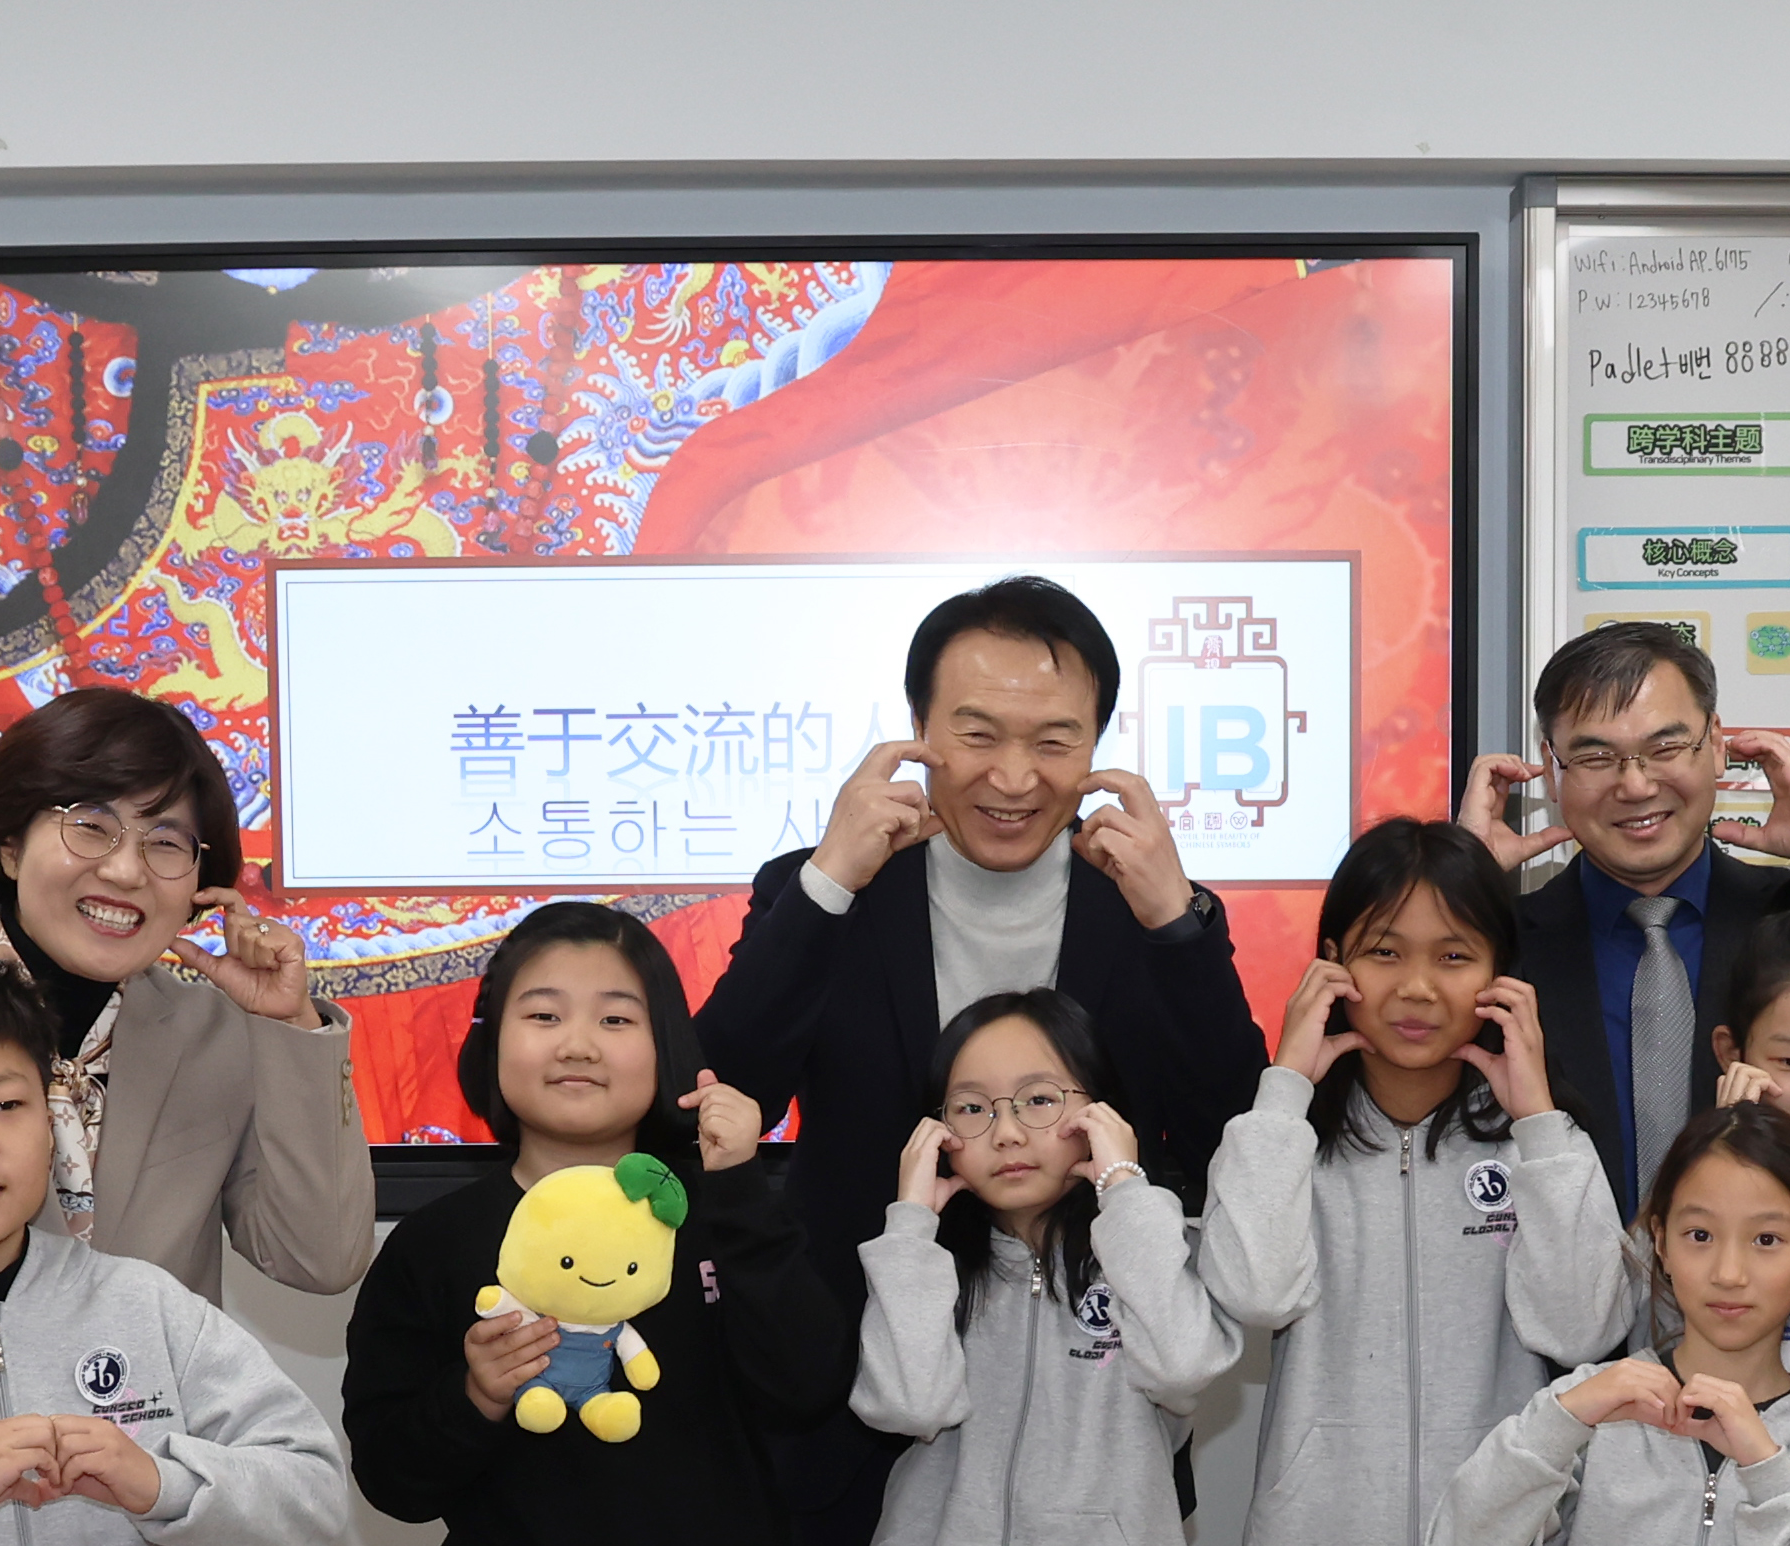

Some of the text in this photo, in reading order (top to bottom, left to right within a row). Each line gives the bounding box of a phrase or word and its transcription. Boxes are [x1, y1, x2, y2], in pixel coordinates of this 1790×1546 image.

[1629, 287, 1710, 311] 12345678
[1725, 337, 1789, 374] 8888
[1627, 424, 1763, 455] 跨学科主题
[1638, 454, 1752, 466] Transdisciplinary Themes
[1643, 538, 1737, 565] 核心概念
[1658, 567, 1720, 580] Key Concepts
[1166, 704, 1272, 790] IB
[466, 797, 739, 862] 소통하는
[120, 1407, 174, 1424] SCHOOL
